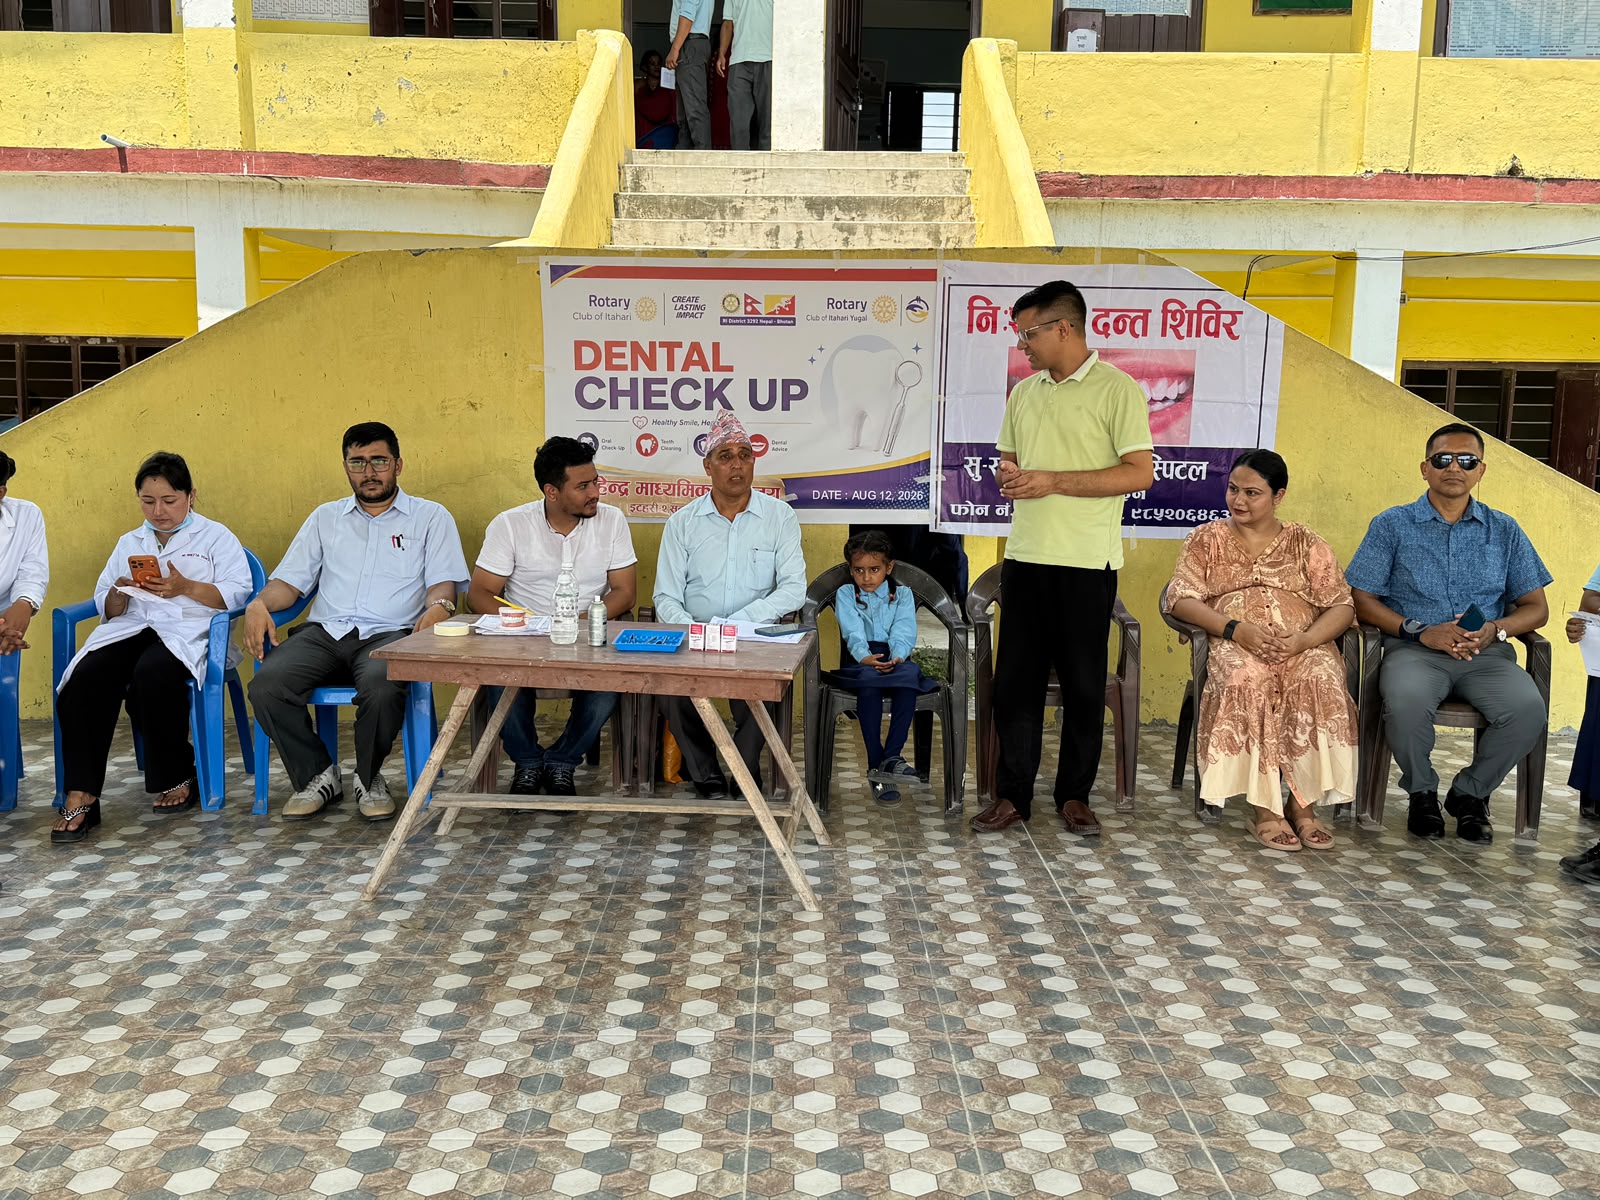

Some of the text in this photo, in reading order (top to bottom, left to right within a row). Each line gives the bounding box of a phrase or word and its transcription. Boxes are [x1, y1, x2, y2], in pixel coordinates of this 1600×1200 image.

[588, 294, 631, 310] Rotary
[826, 297, 868, 313] Rotary
[572, 312, 632, 321] Club of Itahari
[806, 314, 868, 324] Club of Itahari Yugal
[1092, 308, 1152, 339] दन्त
[1161, 298, 1243, 341] शिविर
[573, 339, 735, 373] DENTAL
[574, 376, 809, 412] CHECK UP
[652, 419, 678, 427] Healthy
[679, 419, 700, 427] Smile,
[1152, 453, 1209, 481] स्पिटल
[812, 490, 842, 500] DATE
[851, 490, 876, 500] AUG
[880, 490, 894, 502] 12,
[897, 490, 924, 500] 2026
[950, 500, 990, 516] फोन
[1131, 508, 1232, 522] ९८५२०६४६३
